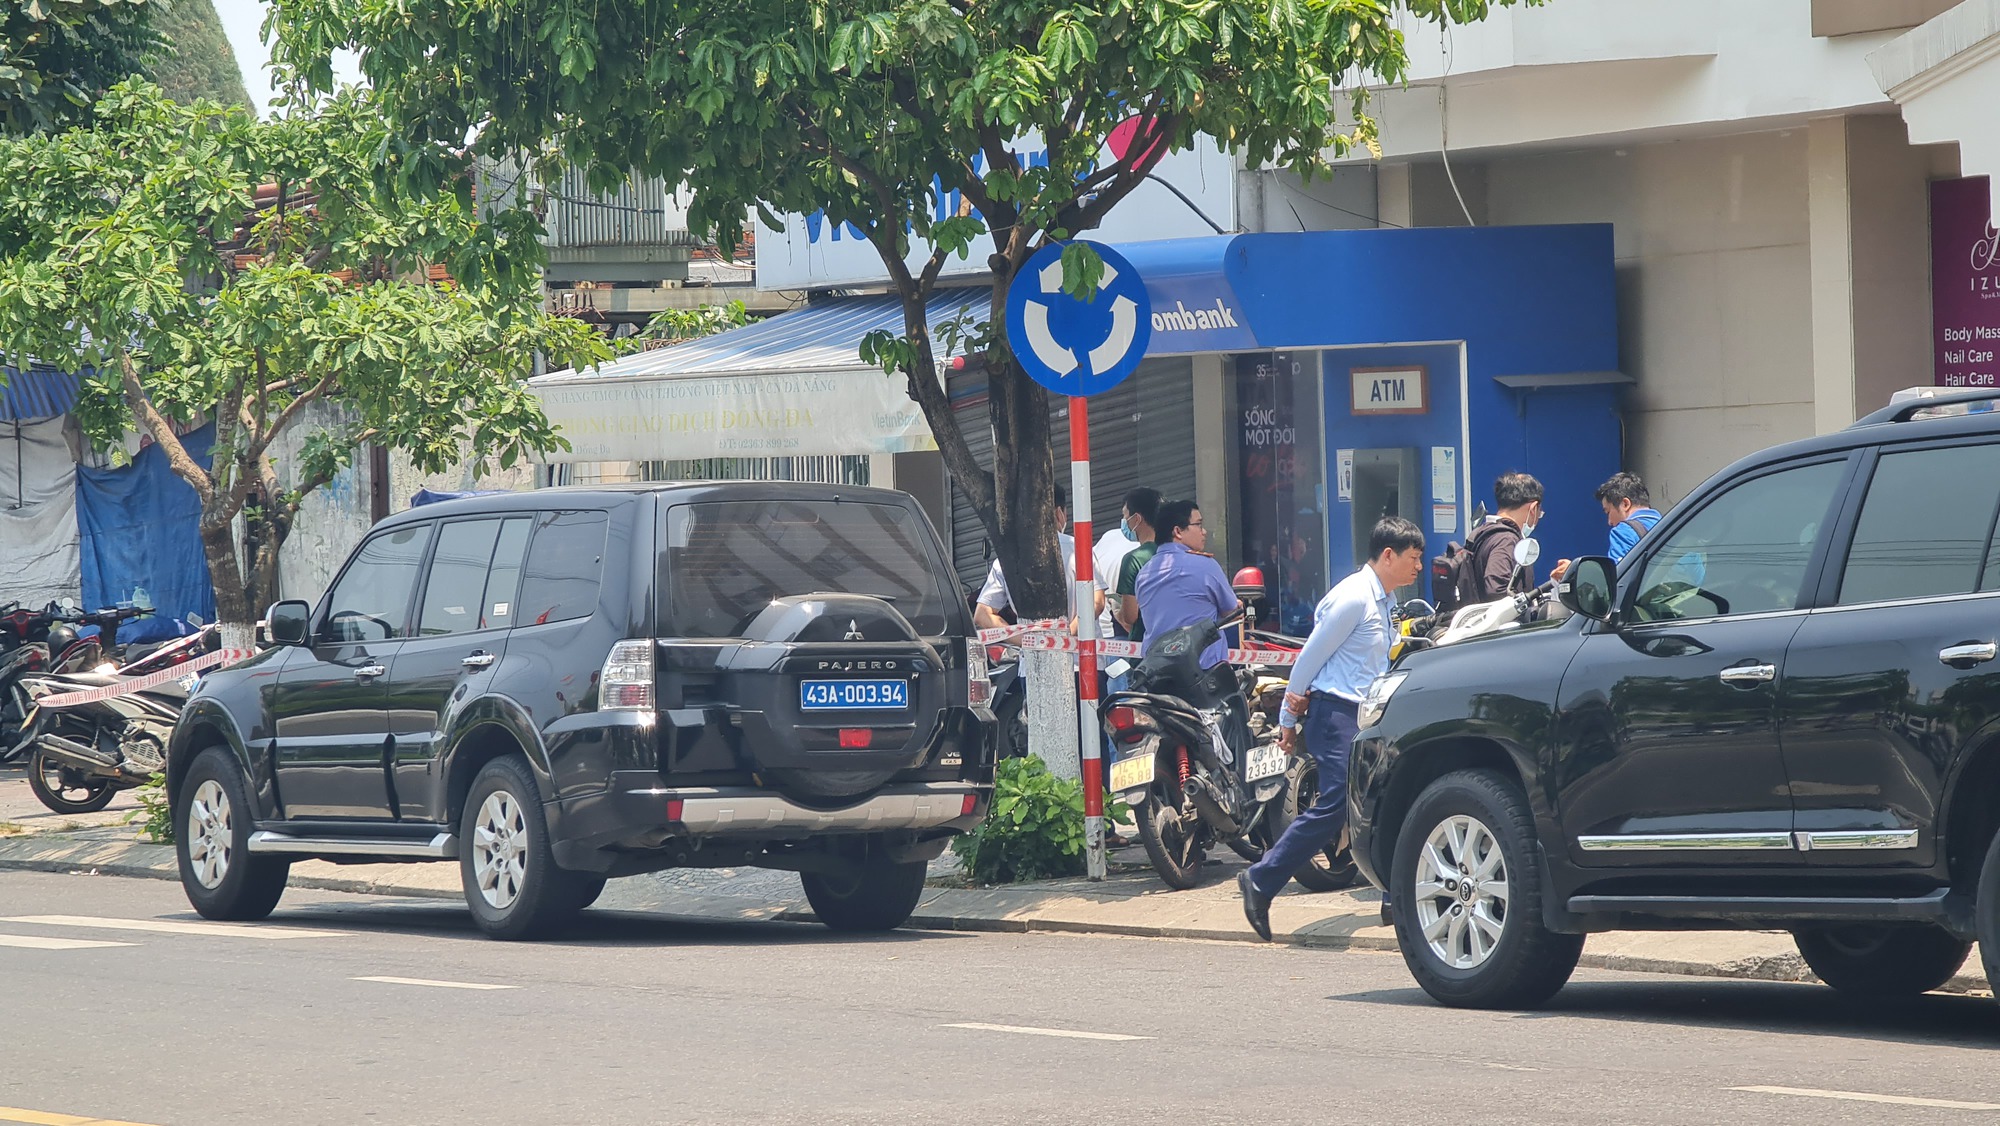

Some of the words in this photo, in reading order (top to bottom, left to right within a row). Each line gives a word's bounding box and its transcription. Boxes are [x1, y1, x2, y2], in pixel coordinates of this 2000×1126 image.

[1944, 326, 1972, 342] Body
[1944, 350, 1965, 364] Nail
[1968, 349, 1993, 362] Care
[1945, 373, 1966, 386] Hair
[1968, 372, 1994, 385] Care
[592, 389, 621, 402] TMCP
[733, 382, 757, 395] NAM
[1370, 378, 1405, 402] ATM
[619, 414, 663, 433] GIAO
[669, 410, 715, 435] DỊCH
[766, 438, 782, 449] 899
[783, 437, 799, 448] 268
[1245, 425, 1270, 448] MỘT
[1273, 424, 1296, 445] ĐỜI
[818, 661, 897, 671] PAJERO
[806, 684, 903, 703] 43A-003.94
[1252, 745, 1280, 763] 43-K1
[1248, 758, 1284, 779] 233.92
